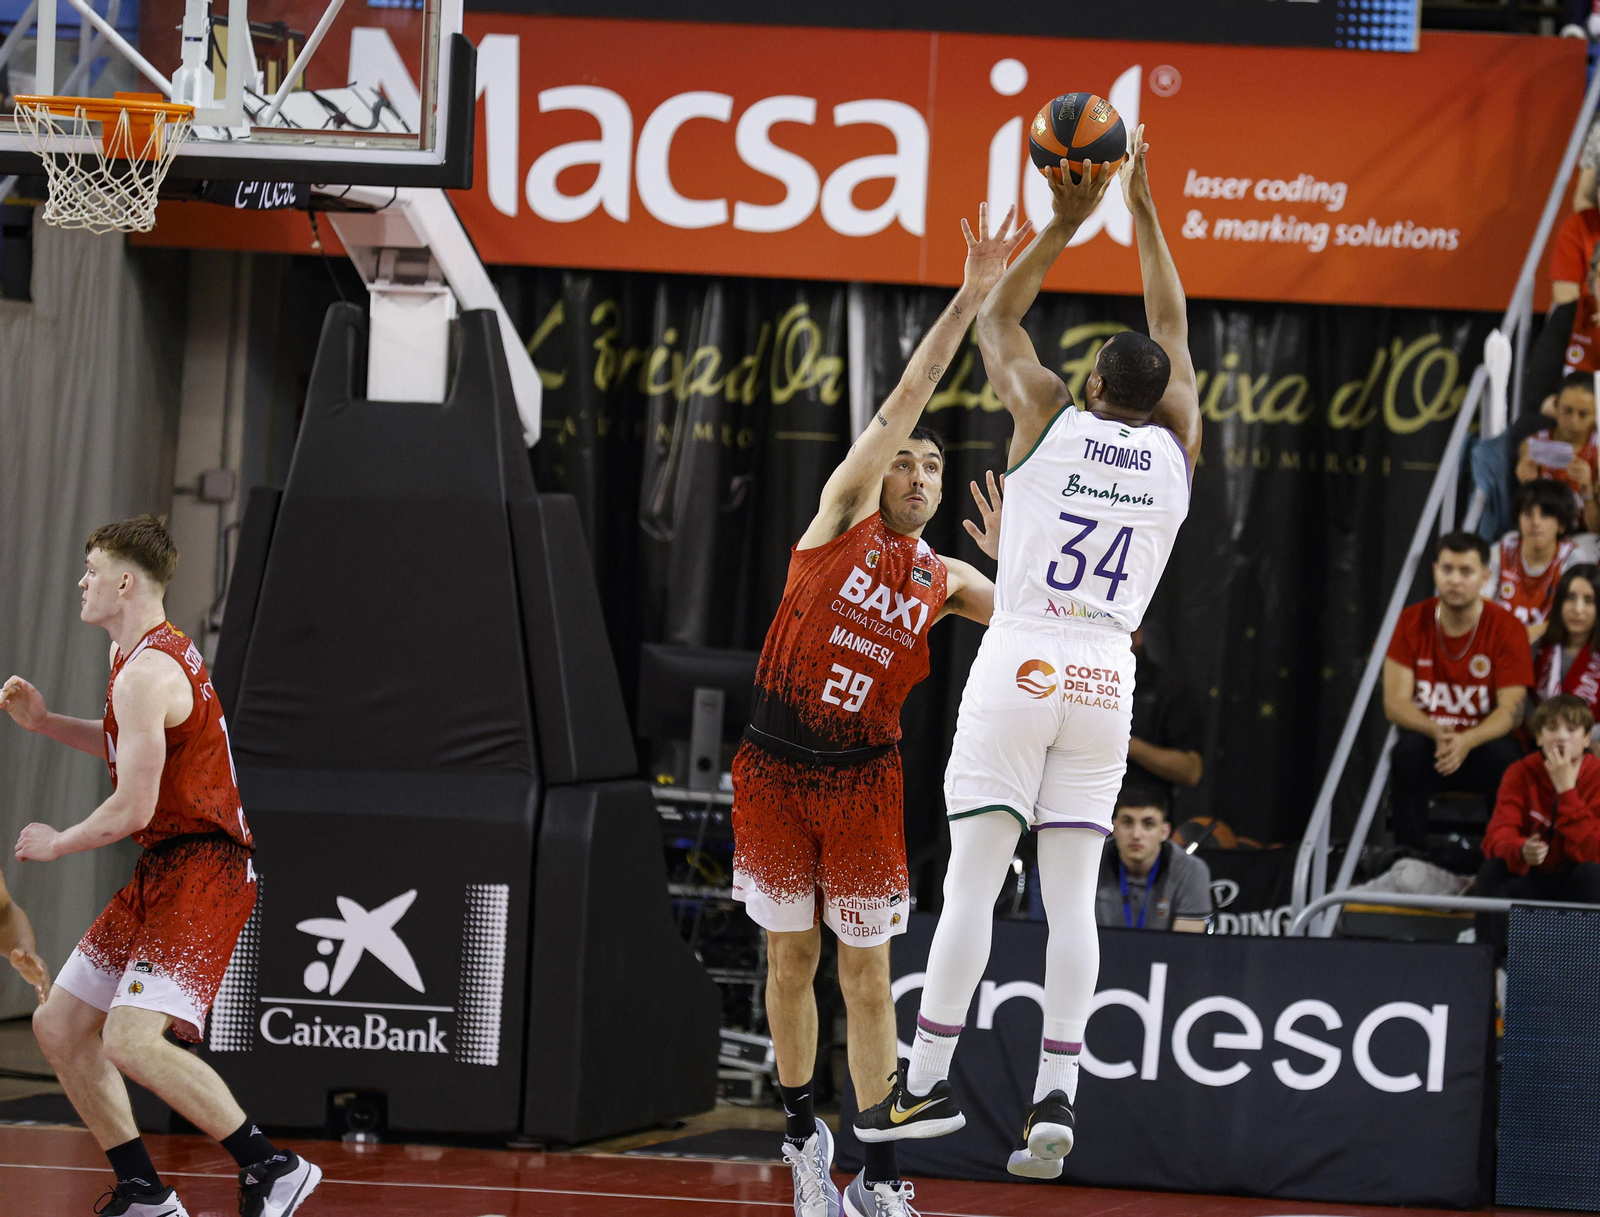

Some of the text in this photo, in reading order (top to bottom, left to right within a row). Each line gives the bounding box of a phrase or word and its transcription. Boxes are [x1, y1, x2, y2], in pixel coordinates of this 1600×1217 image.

[347, 27, 1142, 247] Macsa id
[1184, 168, 1348, 212] laser coding
[1181, 209, 1461, 253] & marking solutions
[1083, 438, 1152, 471] THOMAS
[1046, 511, 1134, 602] 34
[839, 565, 929, 635] BAXI
[831, 599, 916, 650] CLIMATIZACIÓN
[821, 662, 874, 713] 29
[1064, 679, 1121, 698] DEL SOL
[1065, 664, 1121, 684] COSTA
[1062, 692, 1119, 711] MÁLAGA
[840, 908, 864, 925] ETL
[840, 923, 885, 937] GLOBAL
[259, 1006, 449, 1054] CaixaBank
